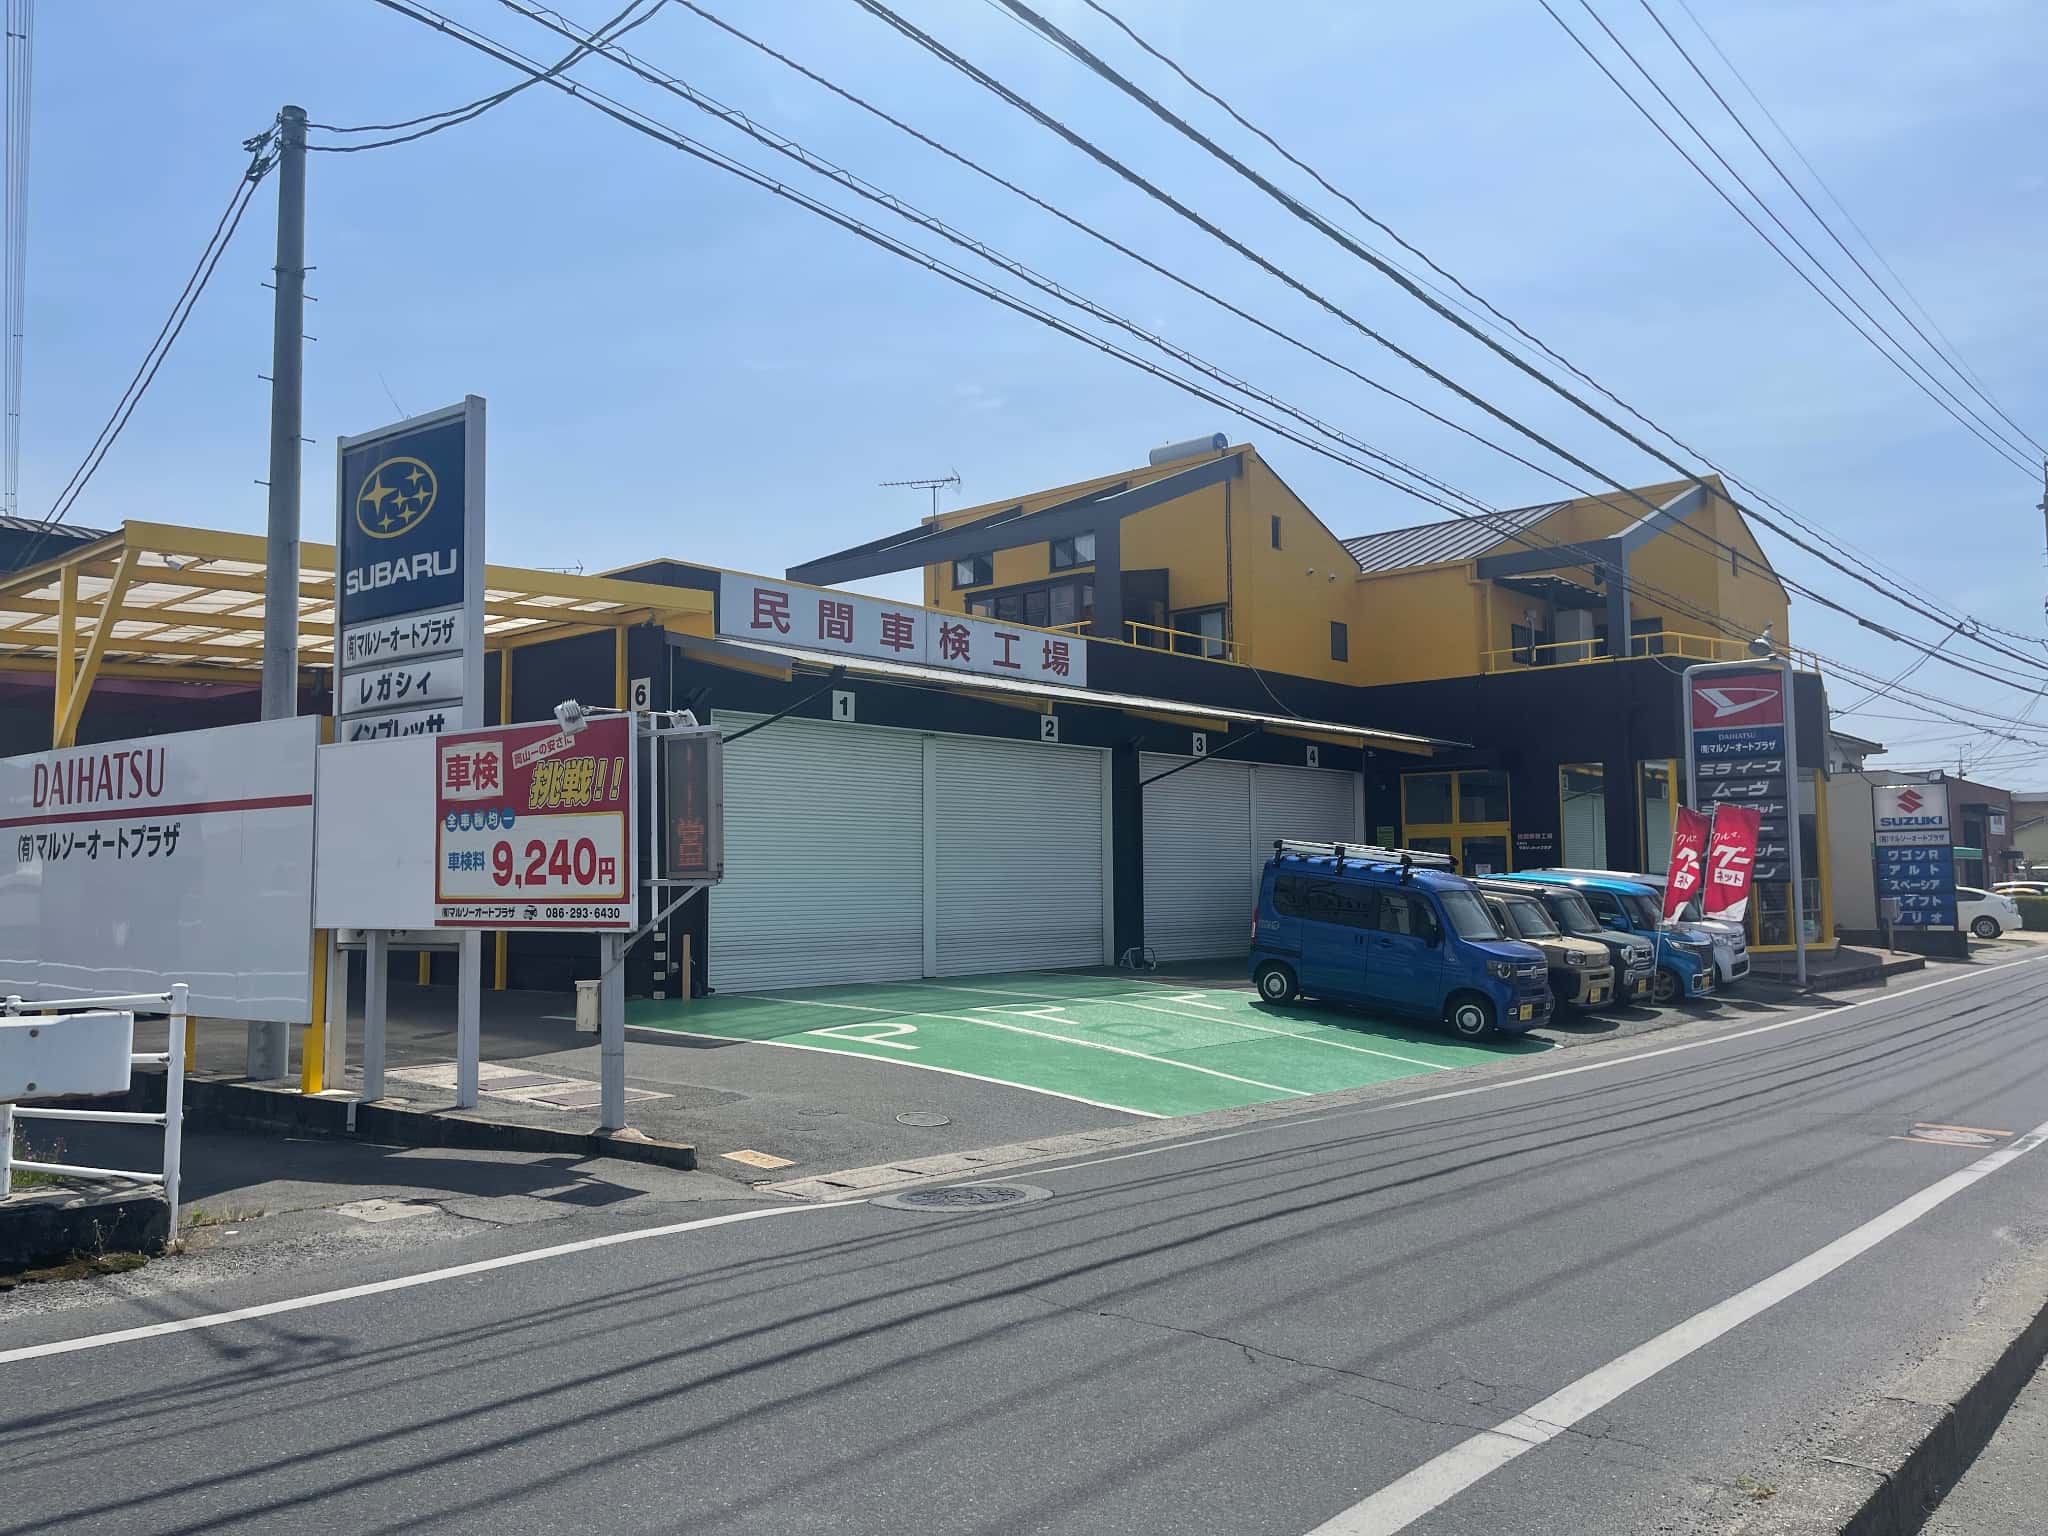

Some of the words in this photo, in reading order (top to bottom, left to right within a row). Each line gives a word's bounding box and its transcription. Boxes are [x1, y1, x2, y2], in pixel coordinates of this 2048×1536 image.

[345, 548, 457, 596] SUBARU
[750, 587, 1070, 678] 民間車検工場
[634, 684, 647, 705] 6
[838, 695, 849, 716] 1
[1044, 719, 1056, 738] 2
[1718, 732, 1755, 741] DAIHATSU
[1195, 736, 1205, 753] 3
[1308, 749, 1318, 765] 4
[32, 747, 167, 809] DAIHATSU
[445, 752, 499, 793] 車検
[1711, 780, 1770, 797] ムーヴ
[1880, 815, 1943, 826] SUZUKI
[447, 851, 485, 872] 車検料
[1887, 849, 1939, 861] ワゴンR
[1716, 870, 1742, 883] ネット
[1888, 864, 1940, 876] アルト
[1890, 879, 1940, 890] スペーシア
